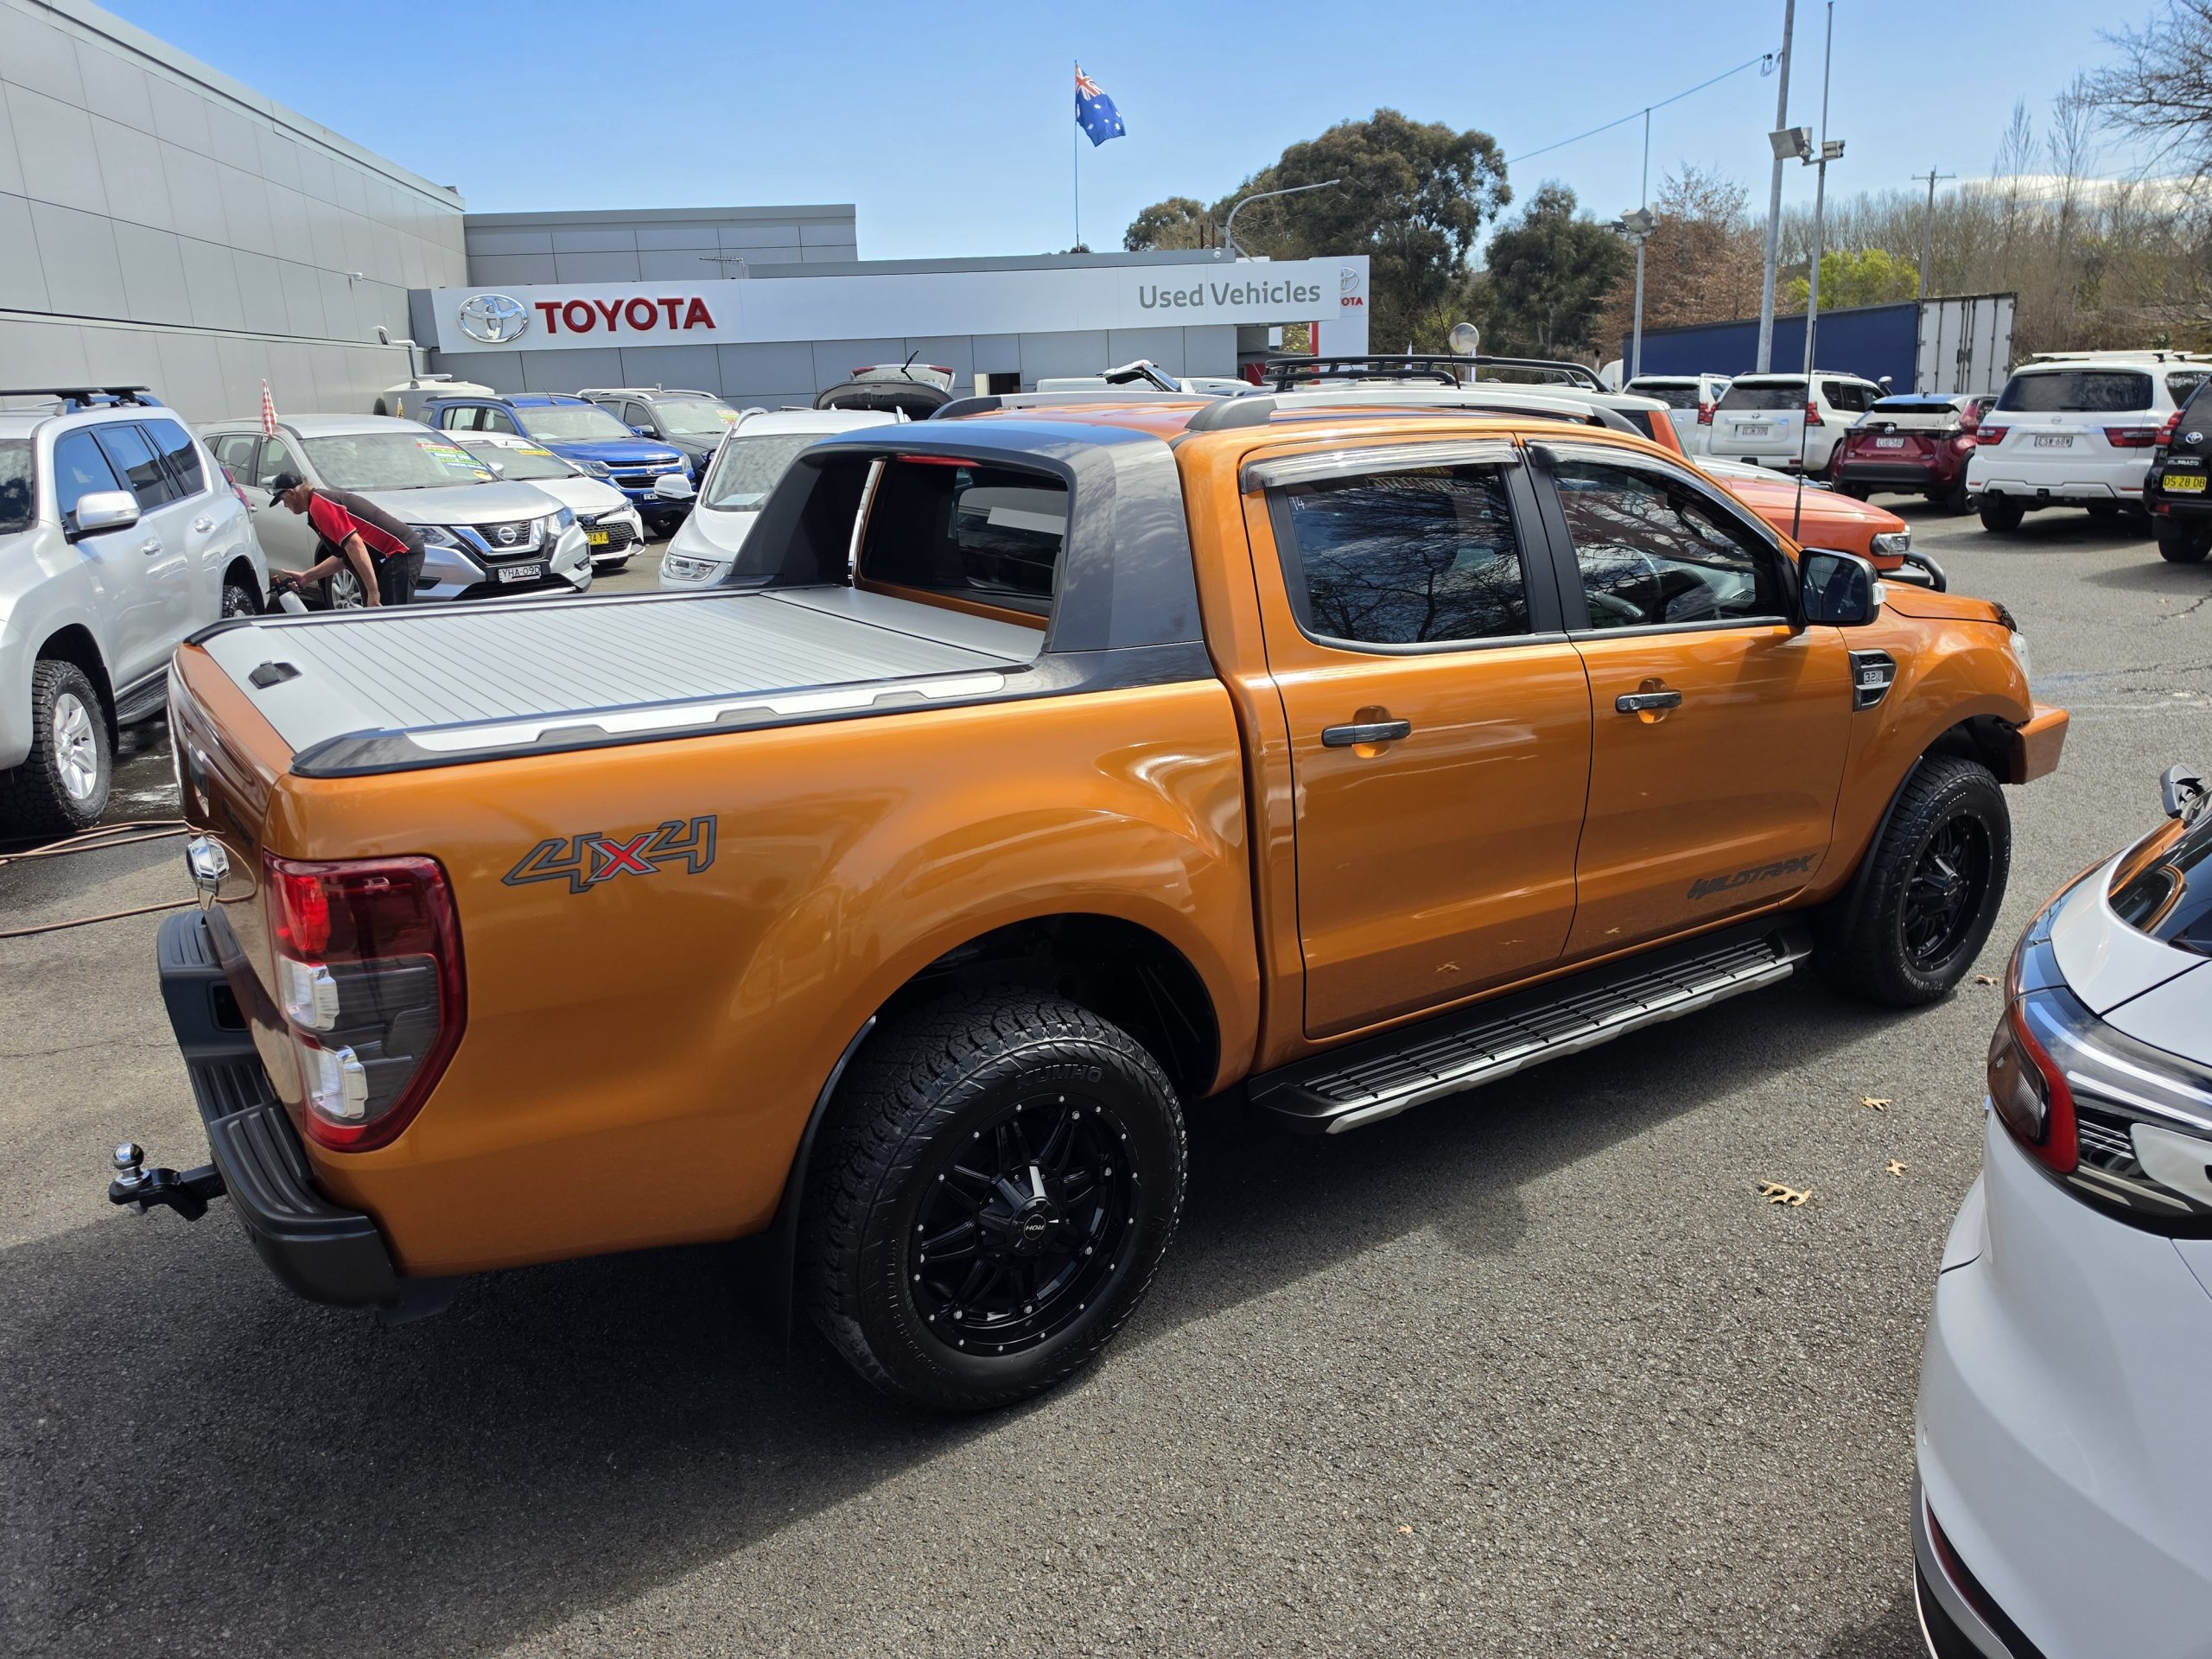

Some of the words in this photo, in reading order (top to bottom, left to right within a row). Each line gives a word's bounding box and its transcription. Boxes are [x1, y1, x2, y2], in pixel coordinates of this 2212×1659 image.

[1139, 283, 1204, 309] Used
[1210, 280, 1321, 306] Vehicles
[1341, 296, 1363, 307] OTA
[534, 296, 716, 334] TOYOTA
[1686, 853, 1818, 900] WILDTRAK
